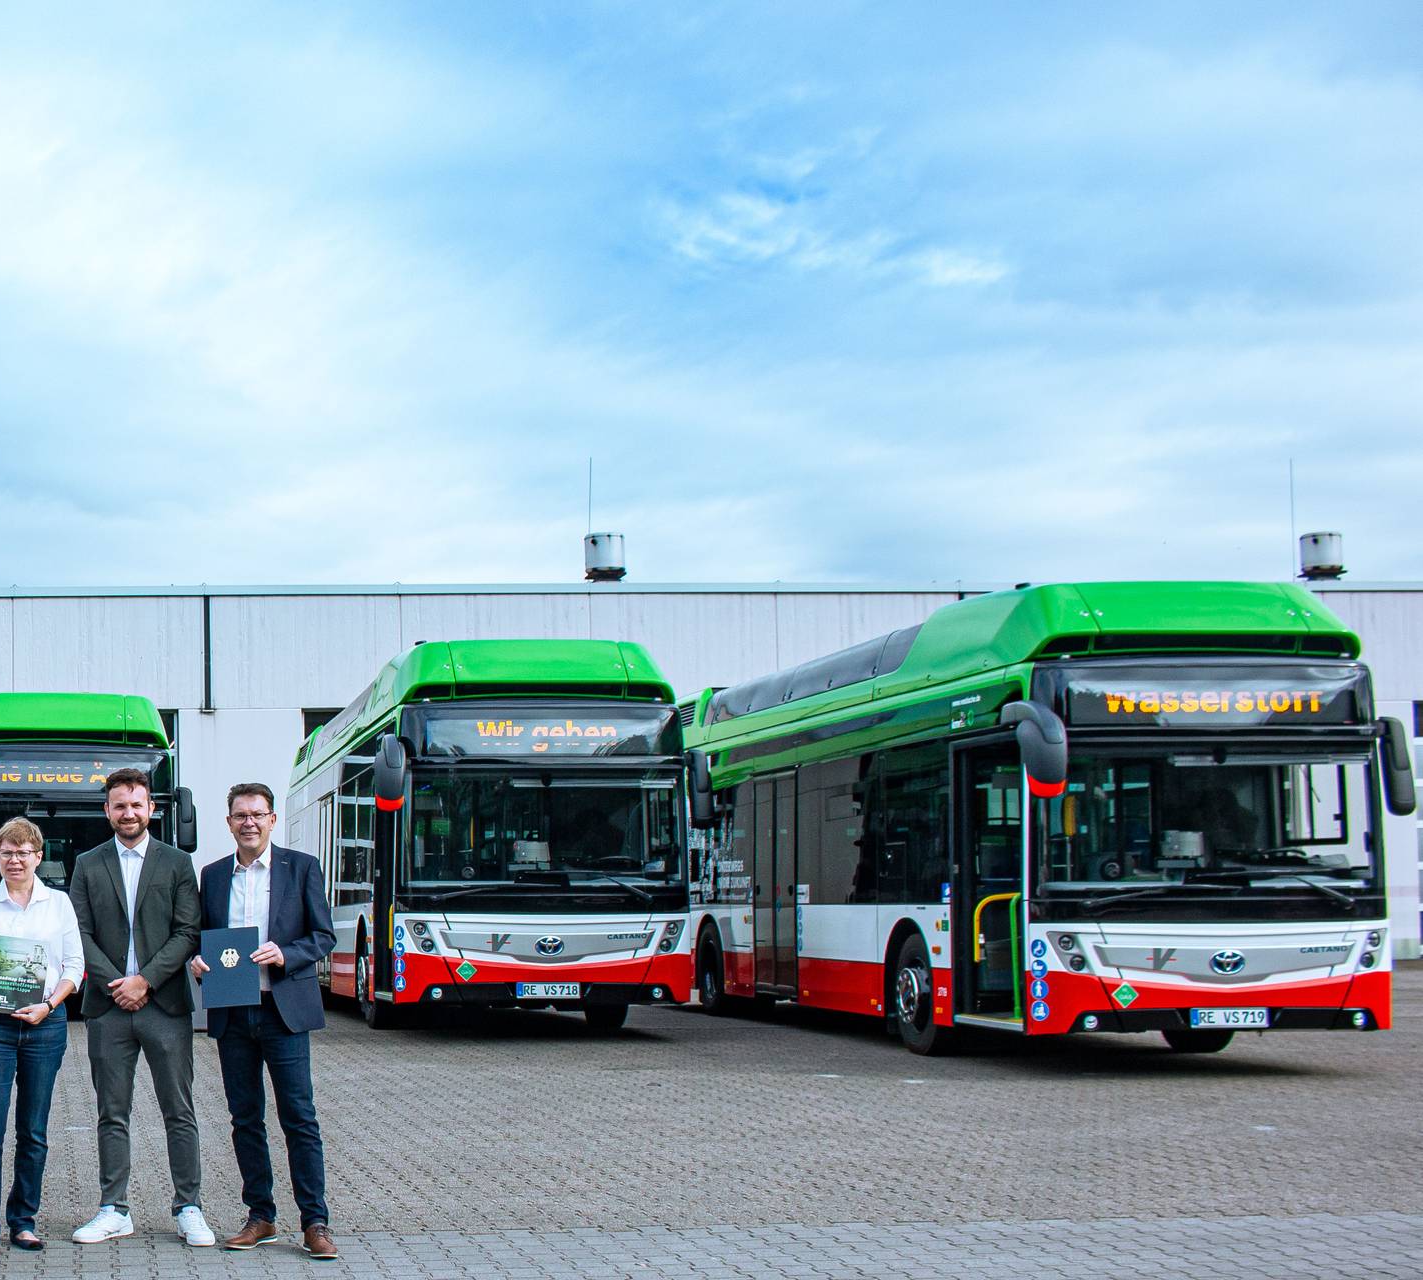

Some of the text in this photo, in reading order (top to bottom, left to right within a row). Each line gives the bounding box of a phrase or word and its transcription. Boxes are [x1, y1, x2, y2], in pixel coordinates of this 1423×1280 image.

[477, 720, 524, 745] Wir
[1300, 945, 1349, 954] CAETANO
[523, 985, 537, 996] RE
[1199, 1011, 1215, 1023] RE
